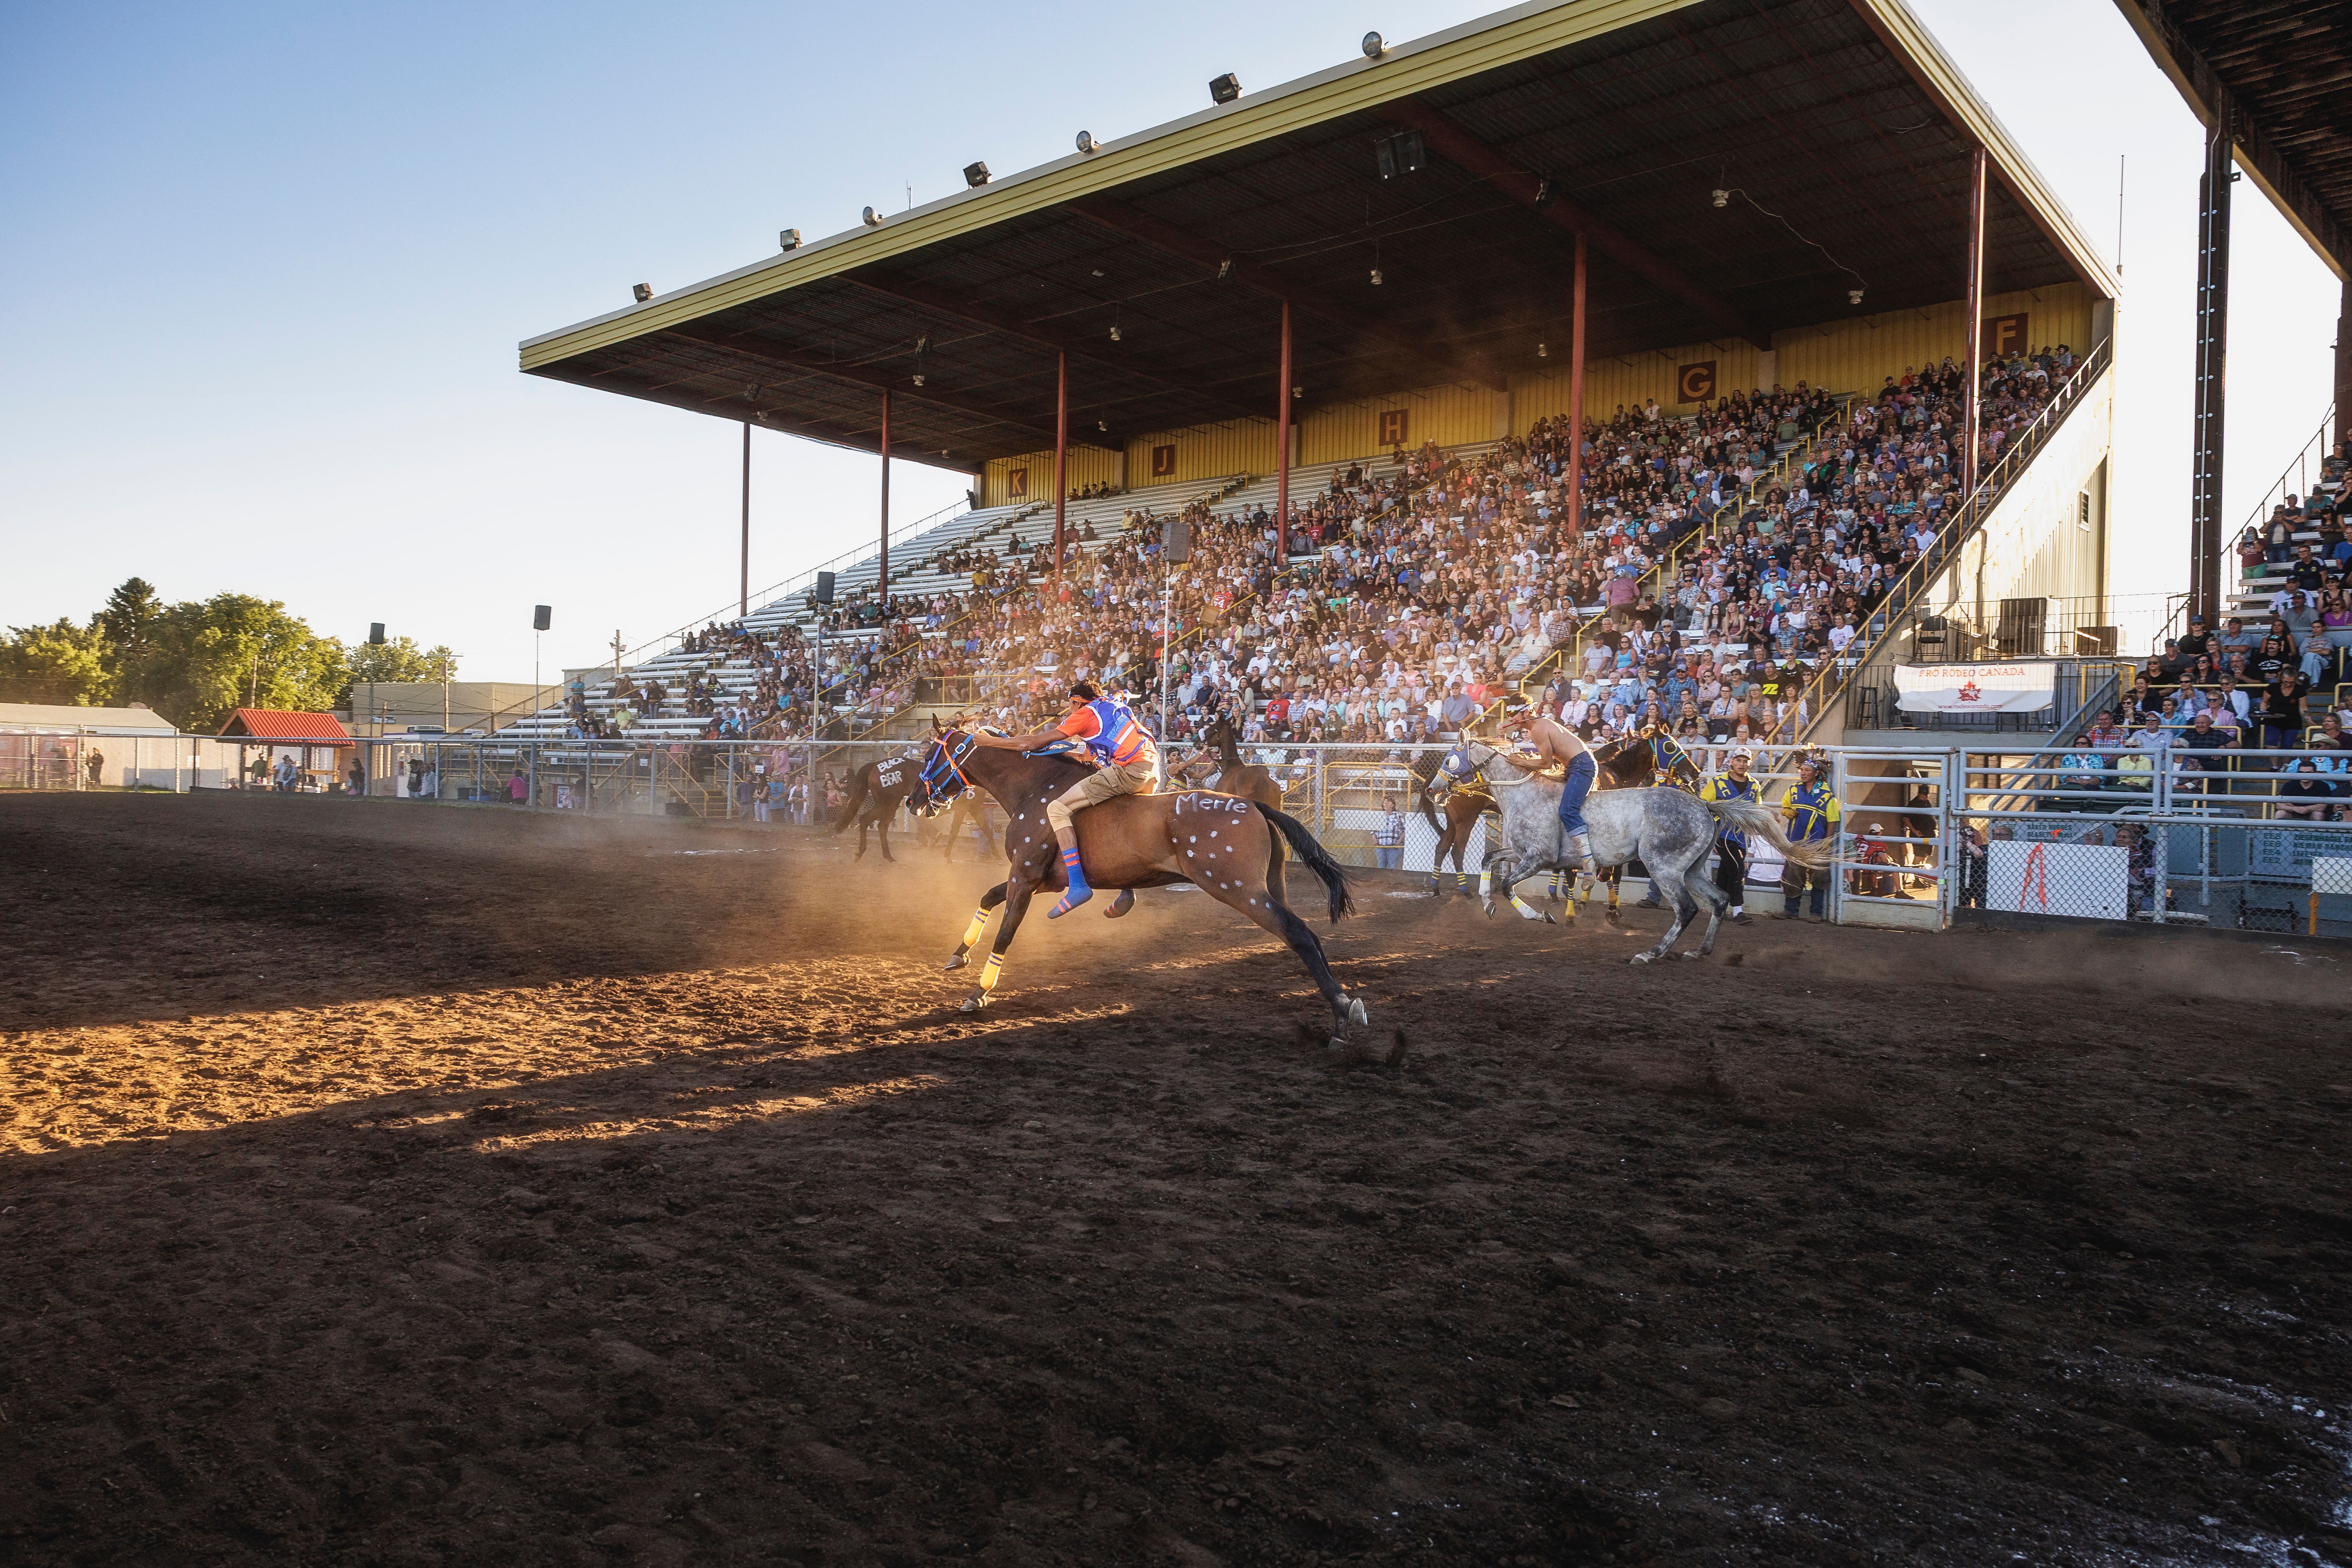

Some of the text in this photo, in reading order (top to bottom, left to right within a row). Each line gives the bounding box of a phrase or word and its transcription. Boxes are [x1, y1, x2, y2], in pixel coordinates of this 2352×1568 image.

[1996, 319, 2016, 355] F
[1683, 368, 1712, 397] G
[1386, 414, 1401, 441] H
[1158, 449, 1167, 472] J
[1013, 472, 1022, 495] K
[1978, 668, 2025, 676] CANADA
[1762, 684, 1779, 695] 72
[877, 757, 906, 773] BLACK
[879, 771, 902, 788] BEAR
[1176, 792, 1248, 815] Merle
